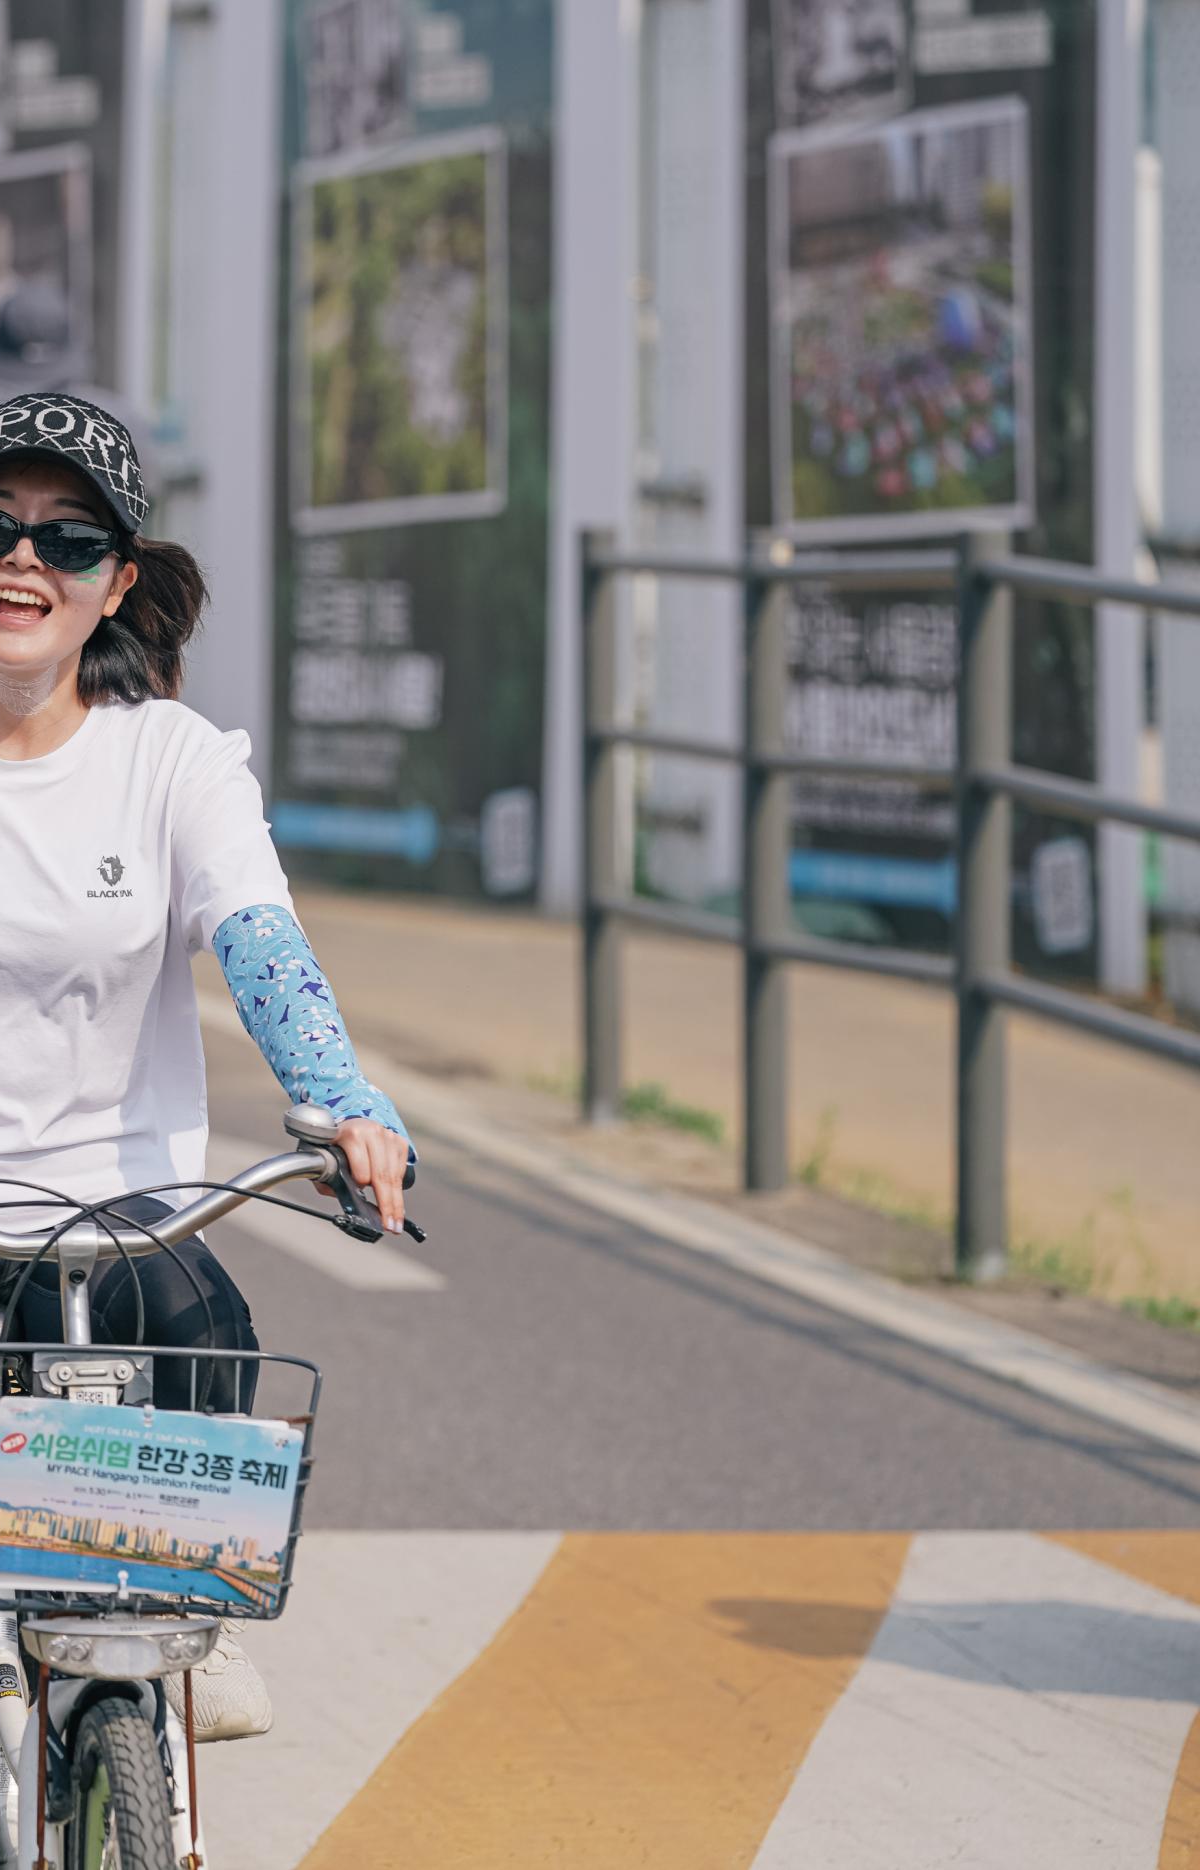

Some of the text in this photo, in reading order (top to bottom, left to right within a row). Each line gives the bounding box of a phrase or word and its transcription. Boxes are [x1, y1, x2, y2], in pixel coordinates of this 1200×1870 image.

[28, 1432, 132, 1469] 쉬엄쉬엄
[138, 1444, 189, 1475] 한강
[191, 1452, 234, 1481] 3종
[238, 1458, 288, 1490] 축제
[47, 1463, 232, 1495] MY PACE Hangang Triathlon Festival
